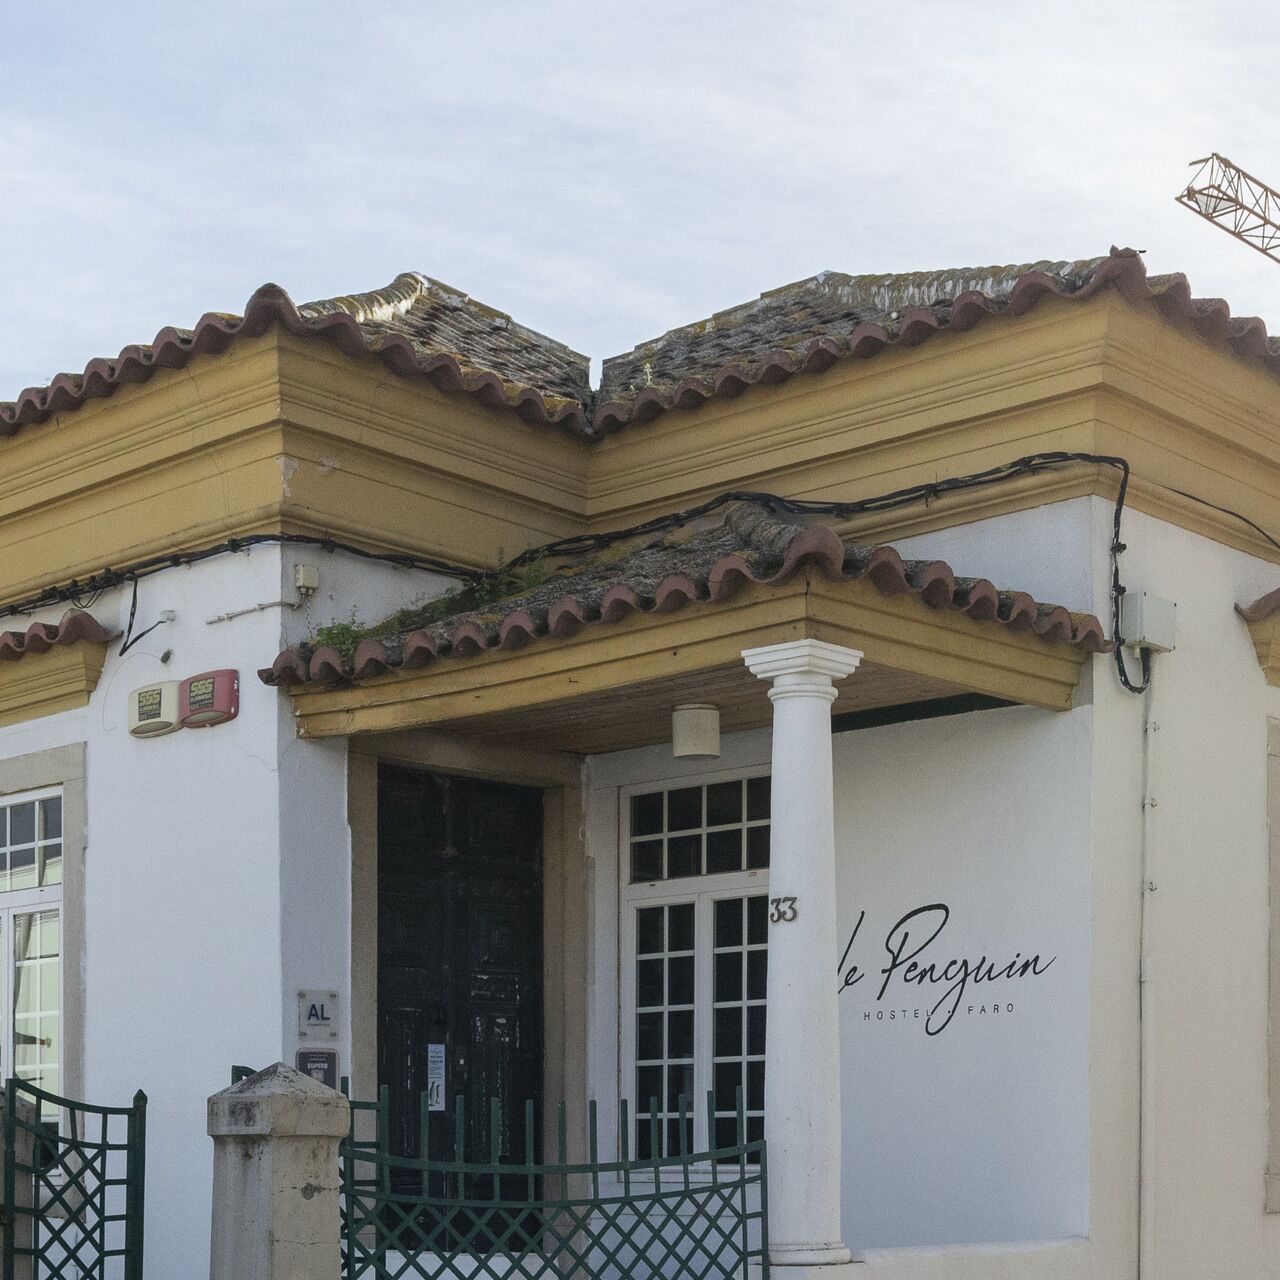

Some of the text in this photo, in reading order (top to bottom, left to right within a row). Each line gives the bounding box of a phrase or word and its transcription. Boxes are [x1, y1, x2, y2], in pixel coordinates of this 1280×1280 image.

[191, 679, 214, 696] SSS
[140, 690, 161, 705] SSS
[770, 896, 798, 923] 33
[877, 903, 1056, 1036] Penguin
[307, 1003, 331, 1021] AL
[863, 1002, 1015, 1021] HOSTEL FARO
